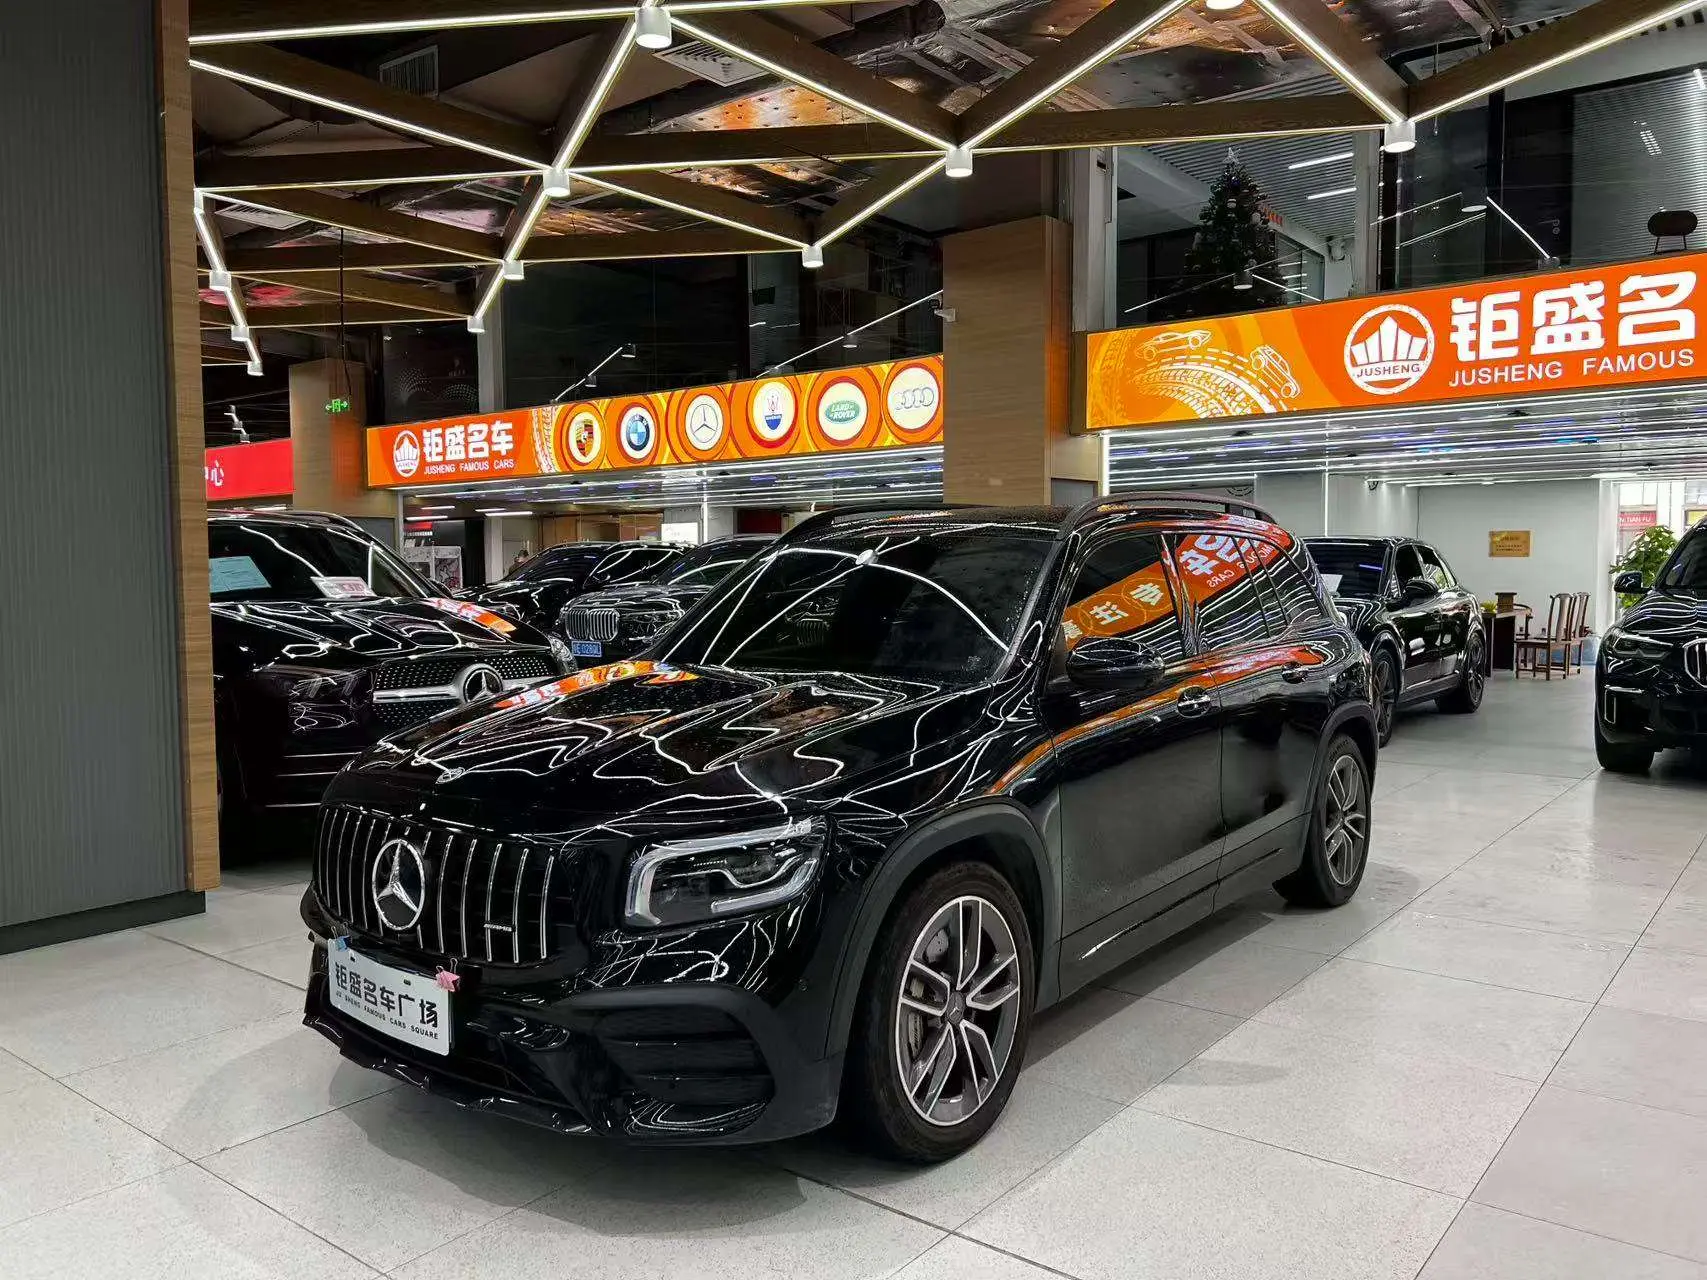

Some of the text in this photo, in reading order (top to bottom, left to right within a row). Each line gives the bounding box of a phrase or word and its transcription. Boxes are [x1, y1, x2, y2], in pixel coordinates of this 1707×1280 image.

[1450, 271, 1697, 362] 钜盛名
[1357, 363, 1421, 378] JUSHENG
[1448, 348, 1694, 387] JUSHENG FAMOUS
[421, 420, 514, 462] 钜盛名车
[424, 458, 514, 475] JUSHENG FAMOUS CARS
[335, 962, 438, 1028] 钜盛名车广场
[364, 1006, 386, 1021] FAMOUS
[389, 1017, 407, 1029] CARS
[410, 1025, 439, 1040] SQUARE
